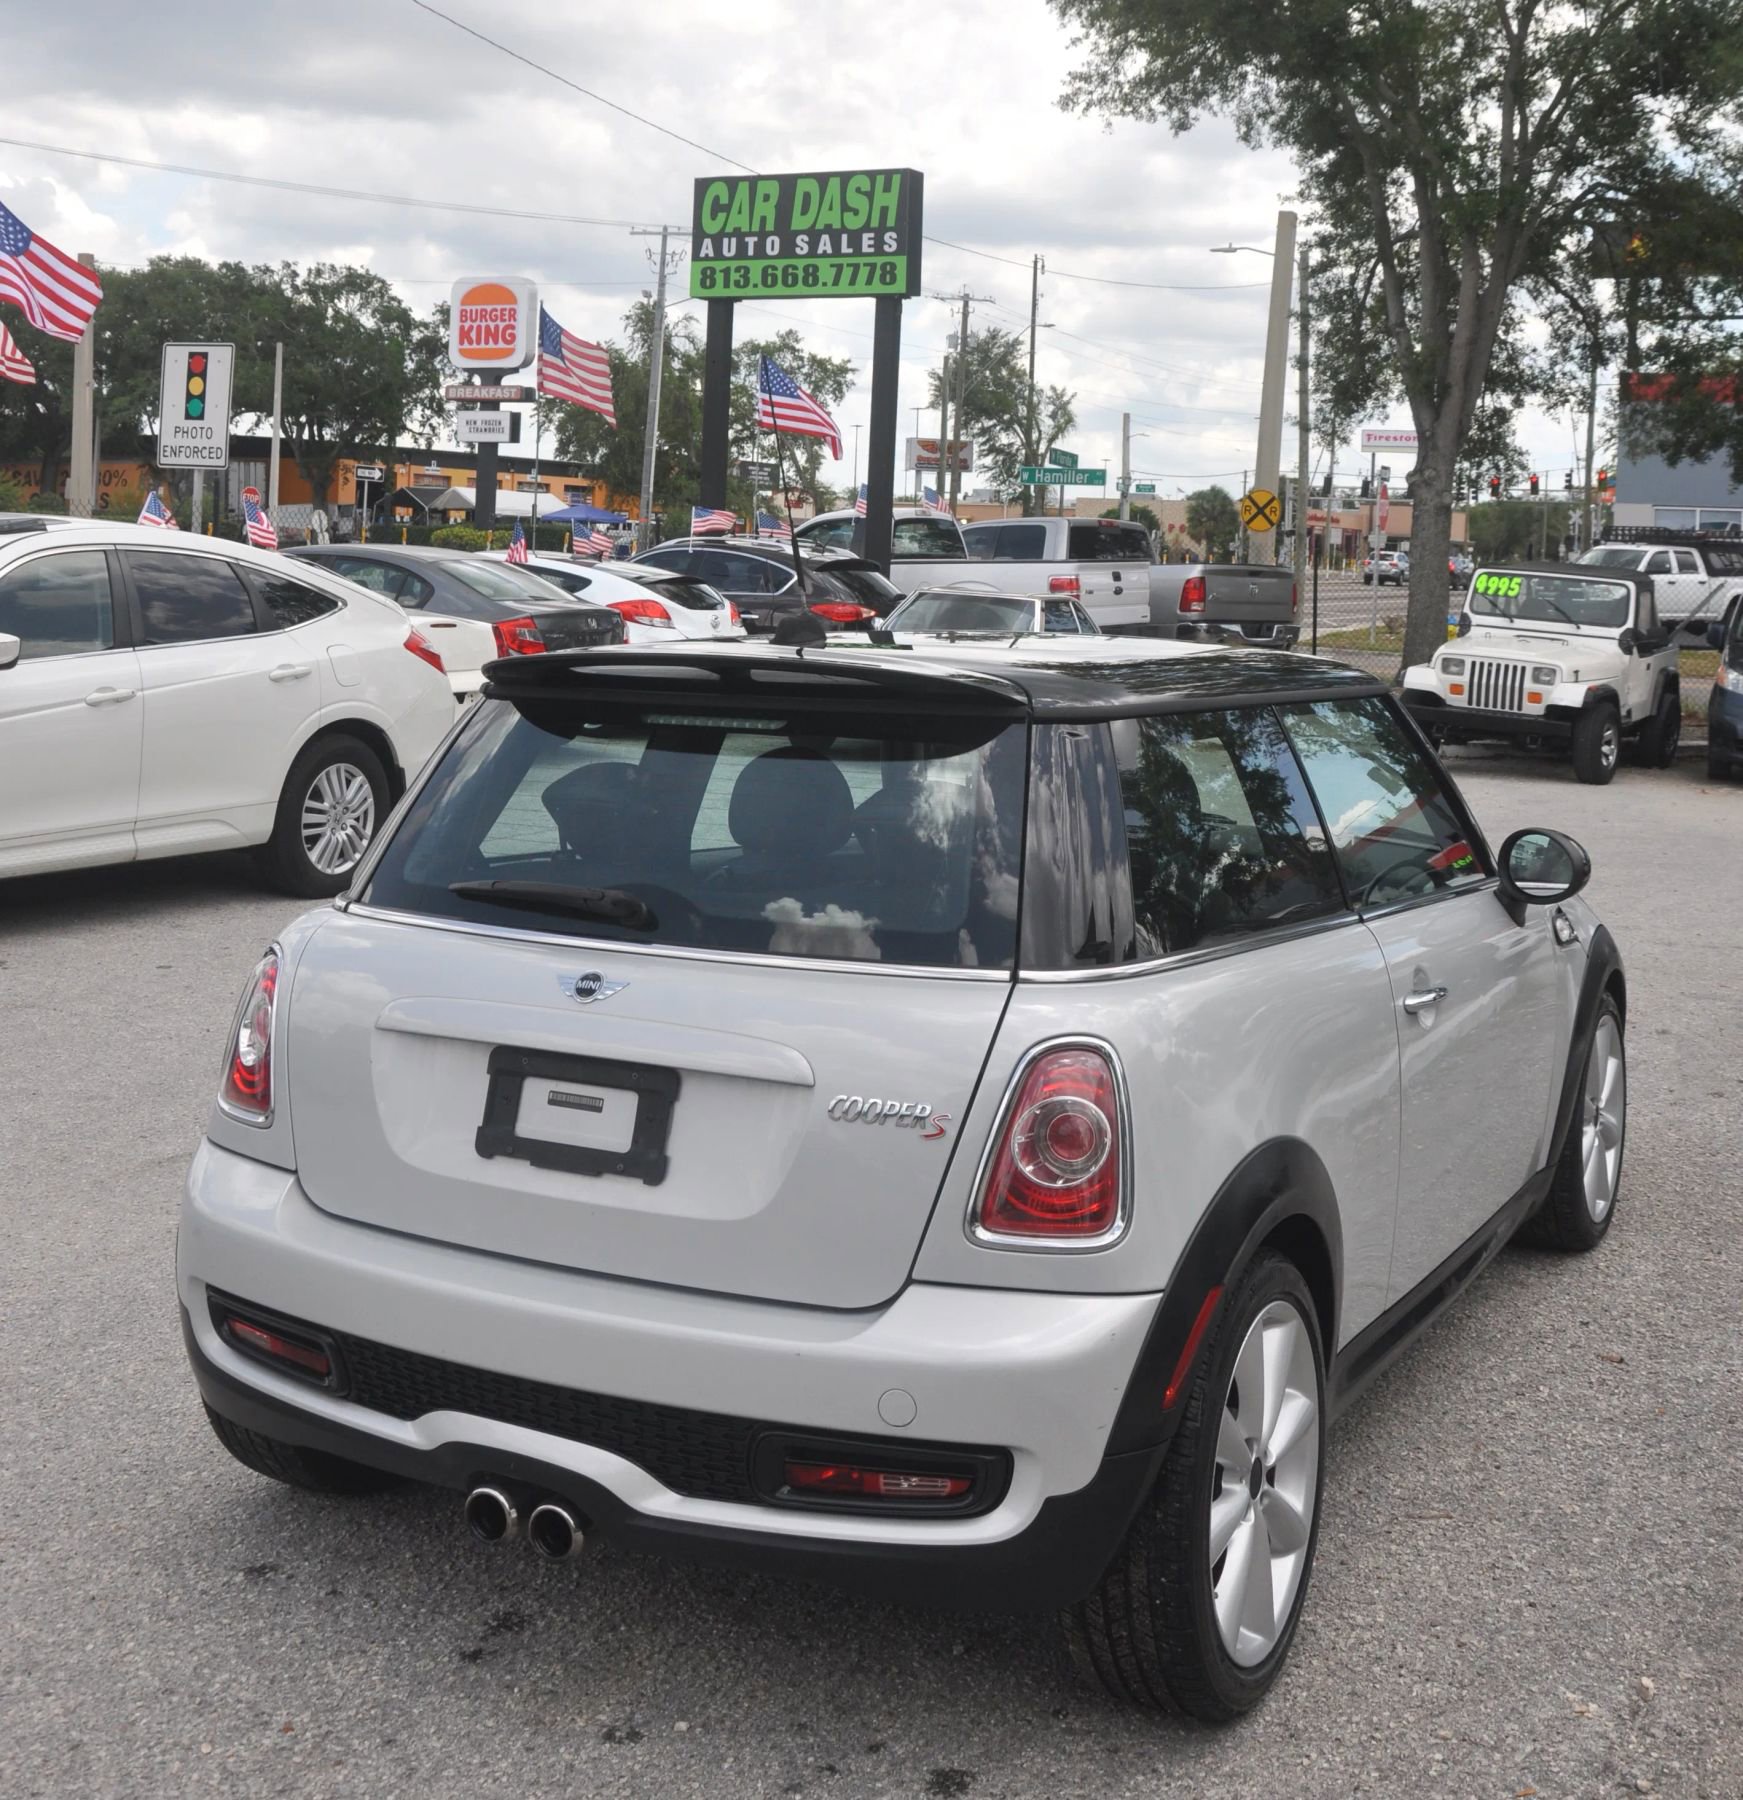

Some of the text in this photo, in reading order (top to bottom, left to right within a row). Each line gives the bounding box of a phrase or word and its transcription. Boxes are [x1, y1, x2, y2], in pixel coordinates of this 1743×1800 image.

[701, 173, 901, 235] CAR DASH
[699, 231, 898, 258] AUTO SALES
[699, 261, 898, 290] 813.668.7778
[459, 307, 517, 323] BURGER
[458, 324, 517, 346] KING
[448, 387, 518, 399] BREAKFAST
[174, 426, 213, 440] PHOTO
[162, 445, 223, 460] ENFORCED
[1035, 469, 1090, 484] Hamiller
[1244, 505, 1278, 516] R R
[576, 980, 601, 991] MINI
[827, 1094, 952, 1142] COOPER S
